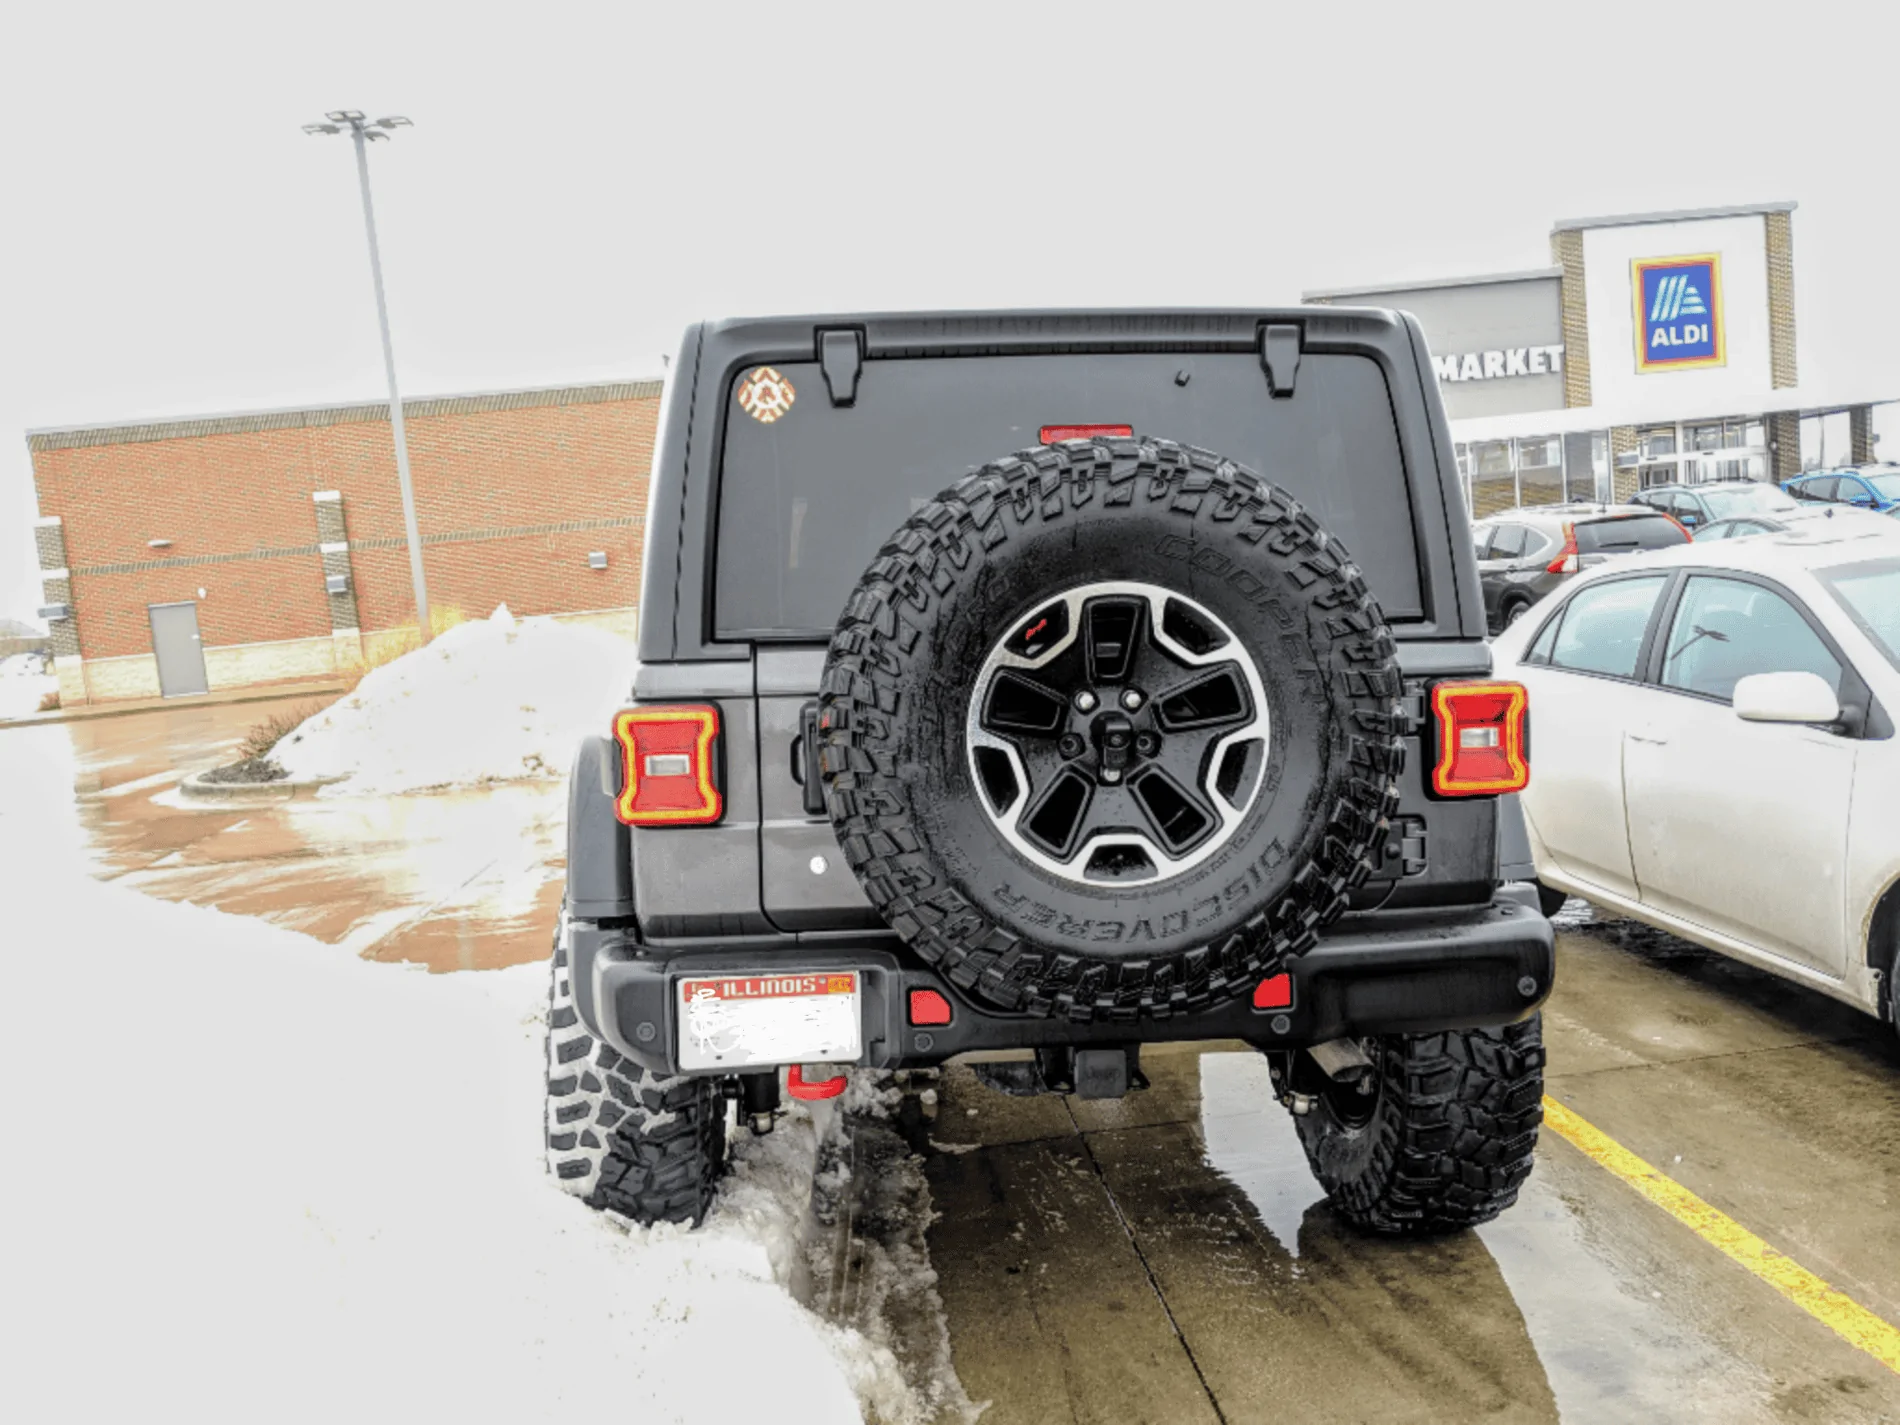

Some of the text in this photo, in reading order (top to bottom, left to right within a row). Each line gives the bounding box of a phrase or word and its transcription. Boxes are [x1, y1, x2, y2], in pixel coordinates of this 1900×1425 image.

[1651, 323, 1708, 348] ALDI
[1430, 344, 1564, 381] MARKET
[994, 837, 1288, 943] DISCOVERER
